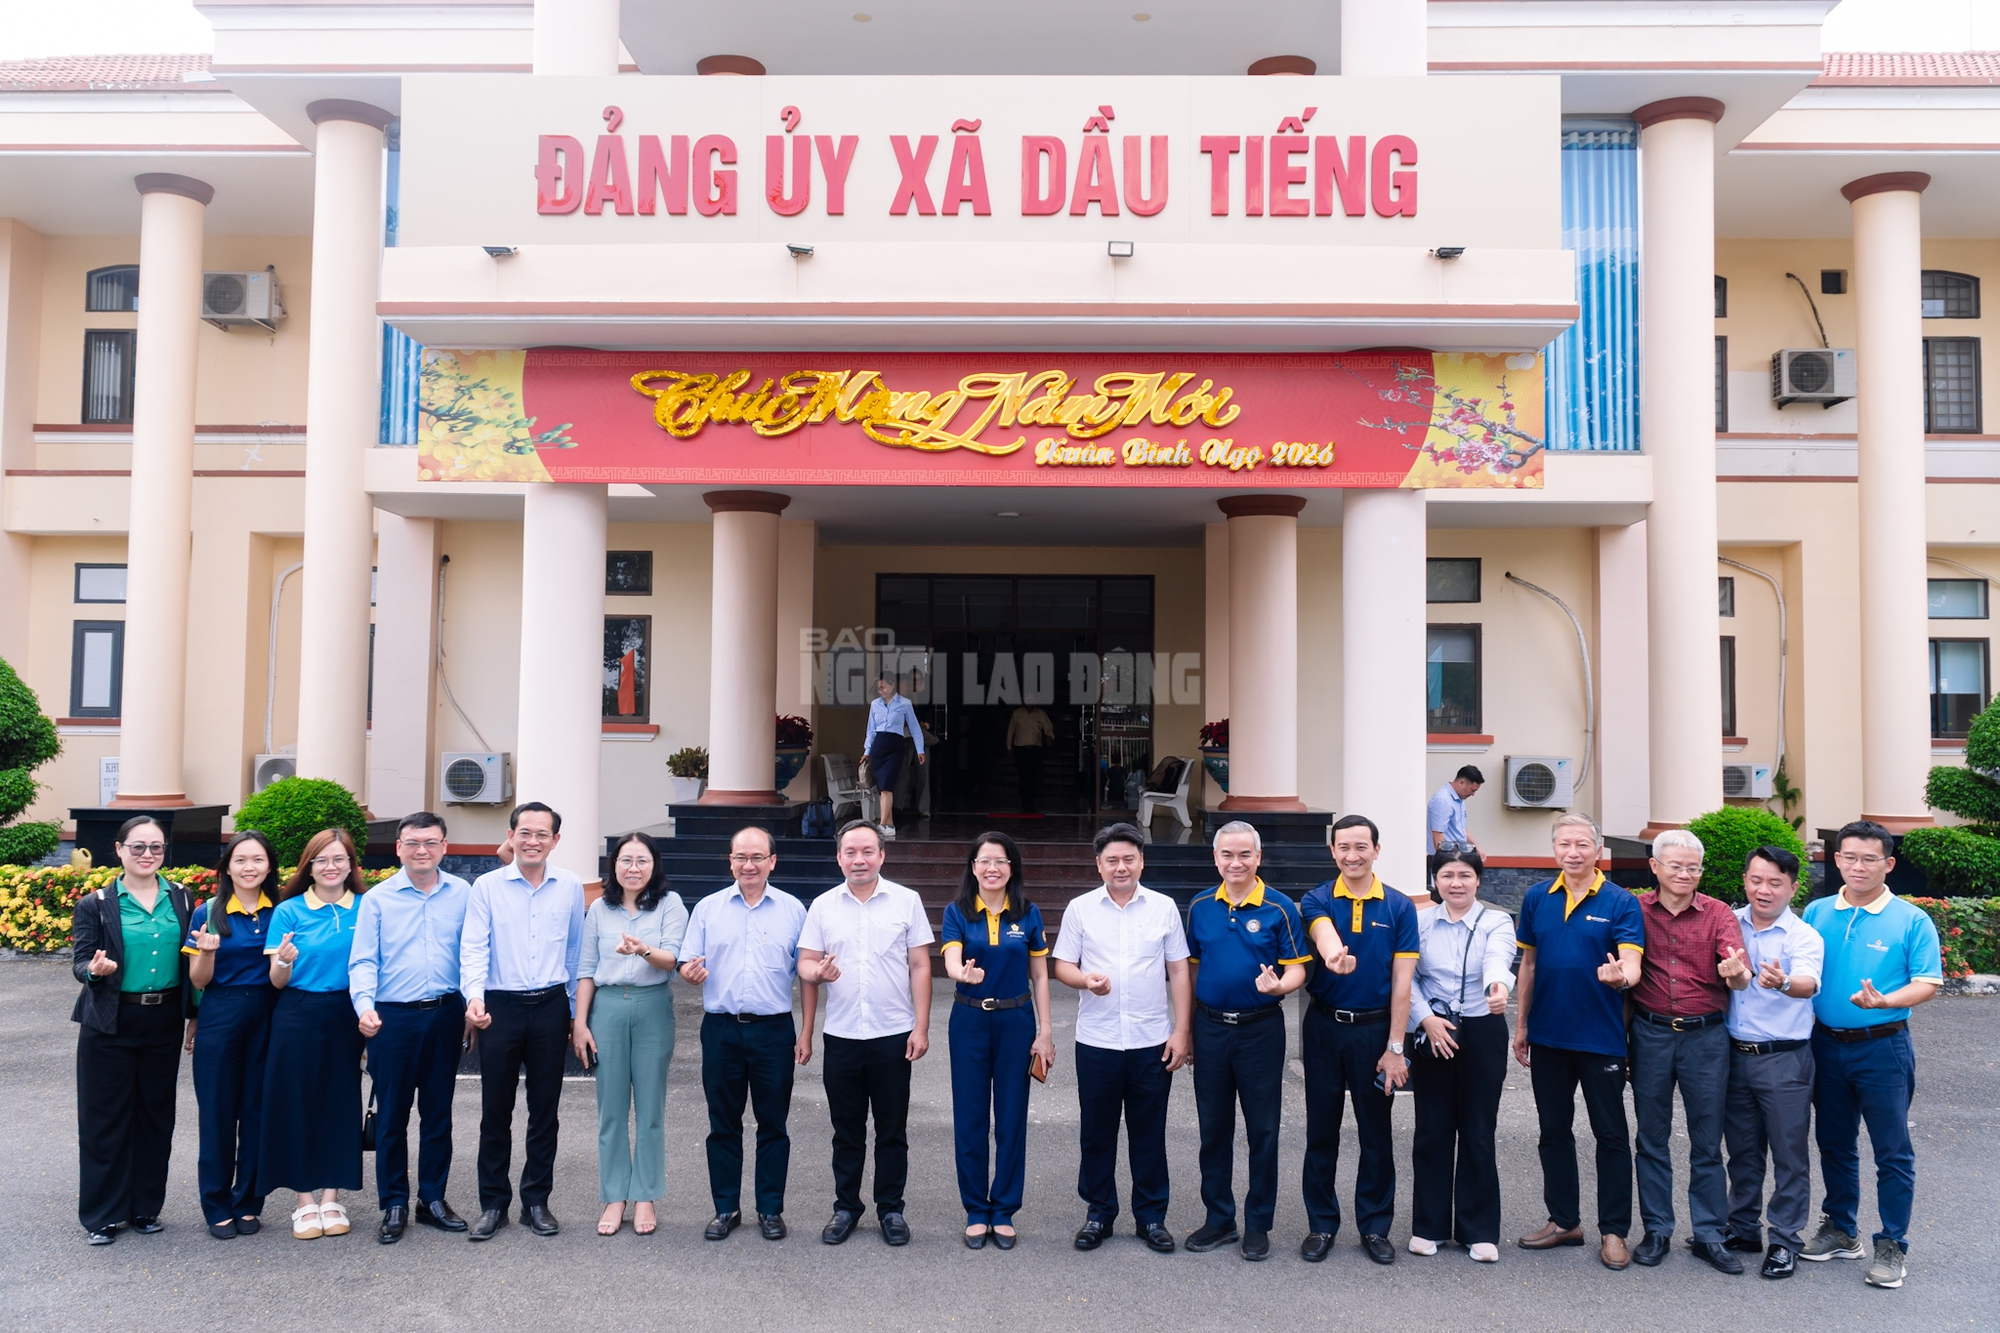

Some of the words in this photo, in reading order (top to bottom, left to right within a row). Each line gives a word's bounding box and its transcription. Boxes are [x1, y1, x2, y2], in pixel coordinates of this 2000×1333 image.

[534, 105, 738, 216] ĐẢNG
[765, 105, 859, 216] ỦY
[889, 118, 992, 216] XÃ
[1021, 105, 1169, 217] DẦU
[1200, 107, 1418, 218] TIẾNG
[630, 368, 800, 439] Chúc
[1066, 371, 1241, 439] Mới
[1035, 437, 1117, 467] Xuân
[1199, 438, 1265, 472] Ngọ
[1268, 441, 1336, 467] 2026
